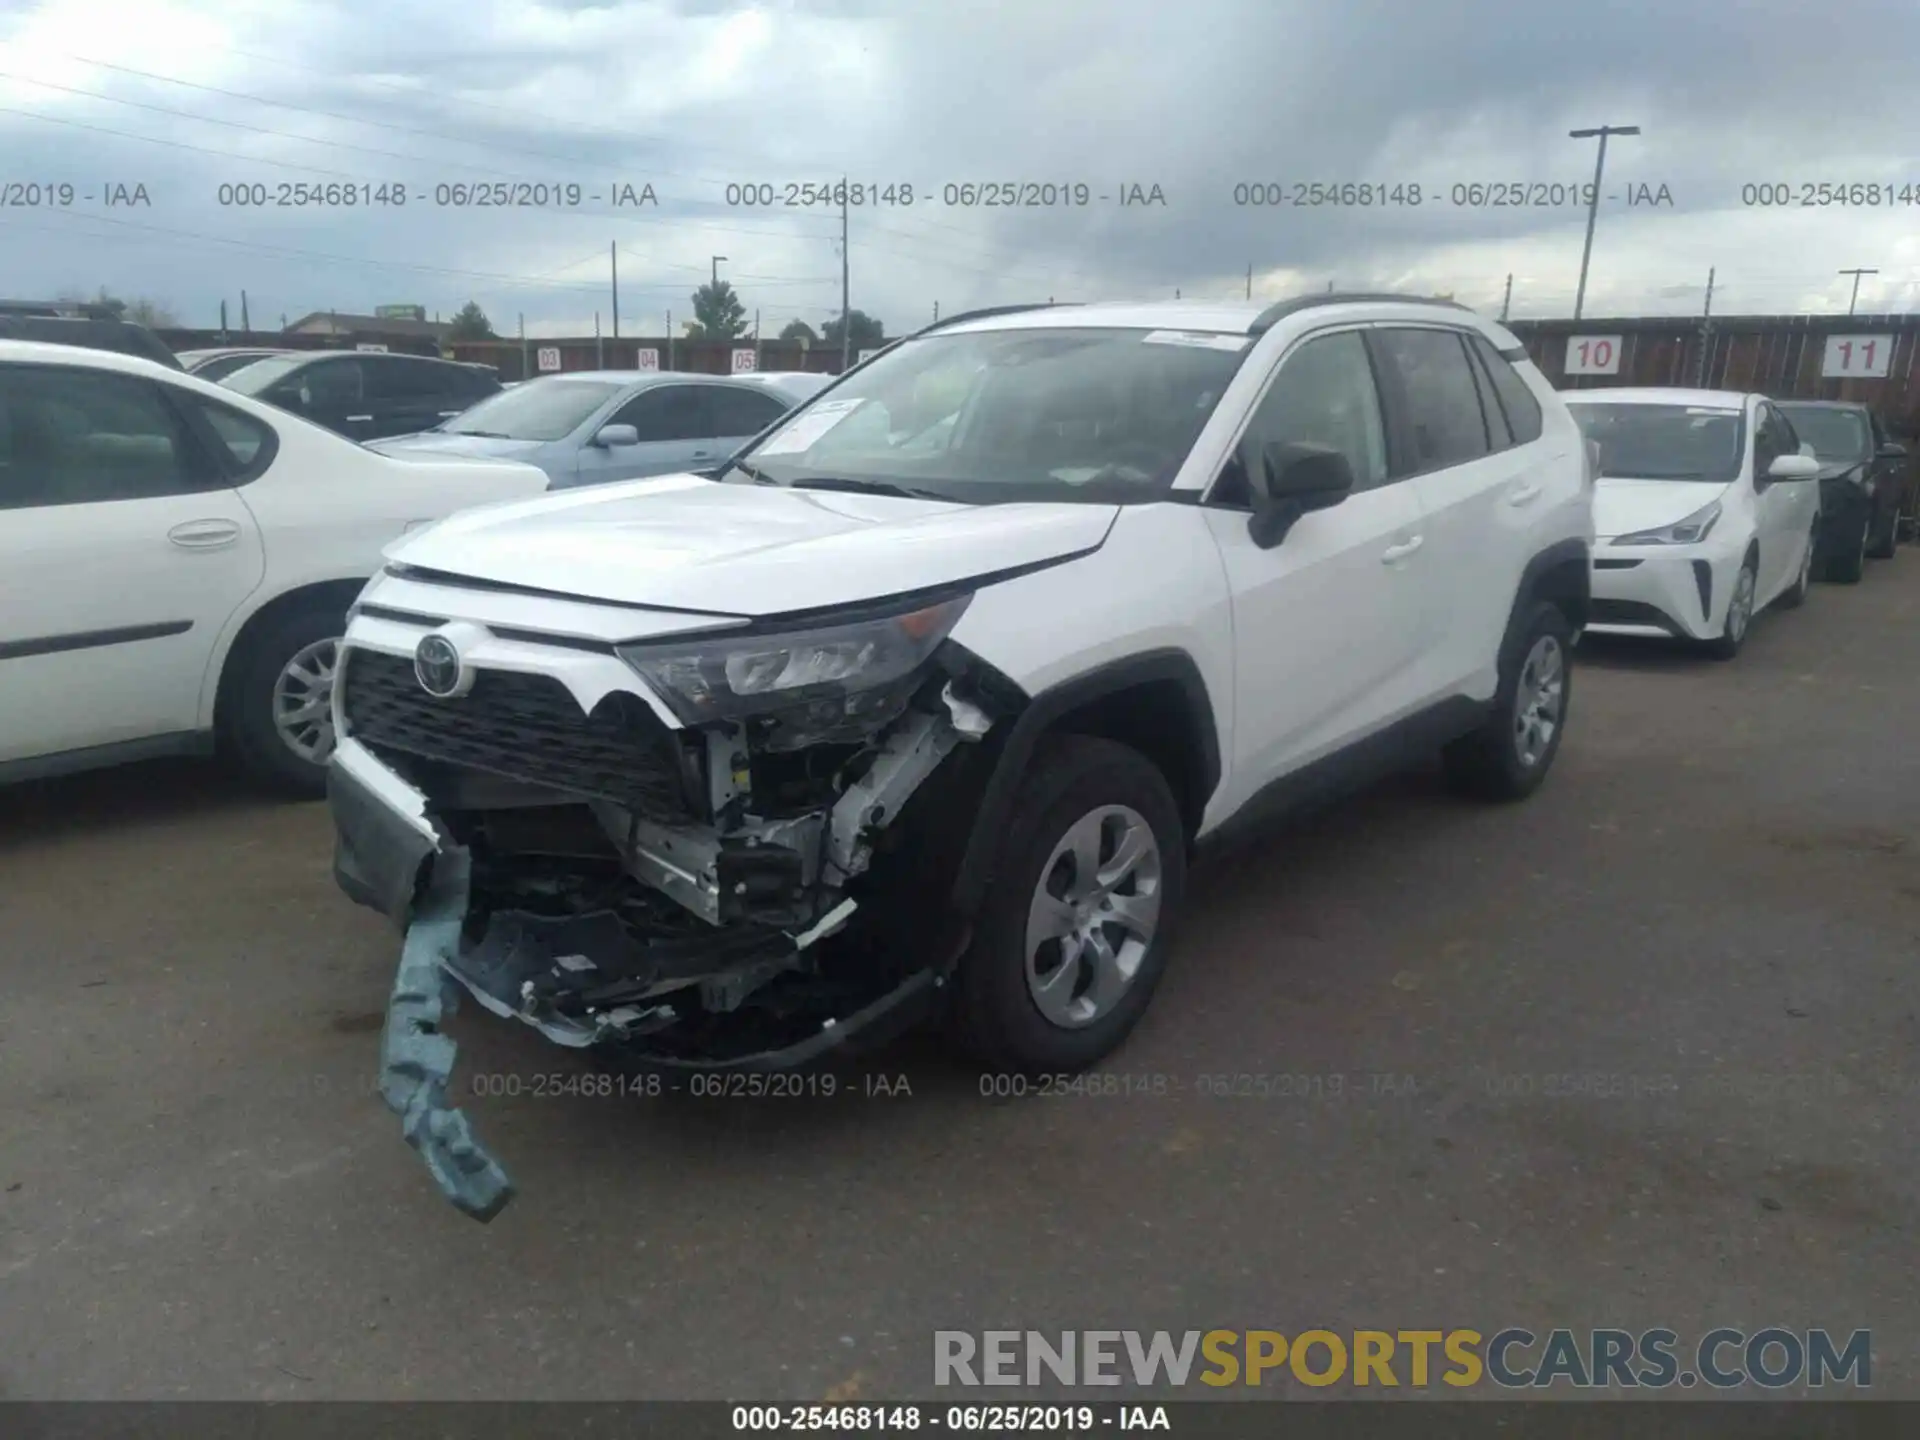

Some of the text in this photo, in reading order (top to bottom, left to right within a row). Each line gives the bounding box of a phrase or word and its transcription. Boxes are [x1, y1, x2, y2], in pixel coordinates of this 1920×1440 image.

[541, 351, 558, 367] 03
[641, 351, 656, 367] 04
[736, 352, 753, 369] 05
[1576, 340, 1612, 368] 10
[1838, 340, 1875, 370] 11
